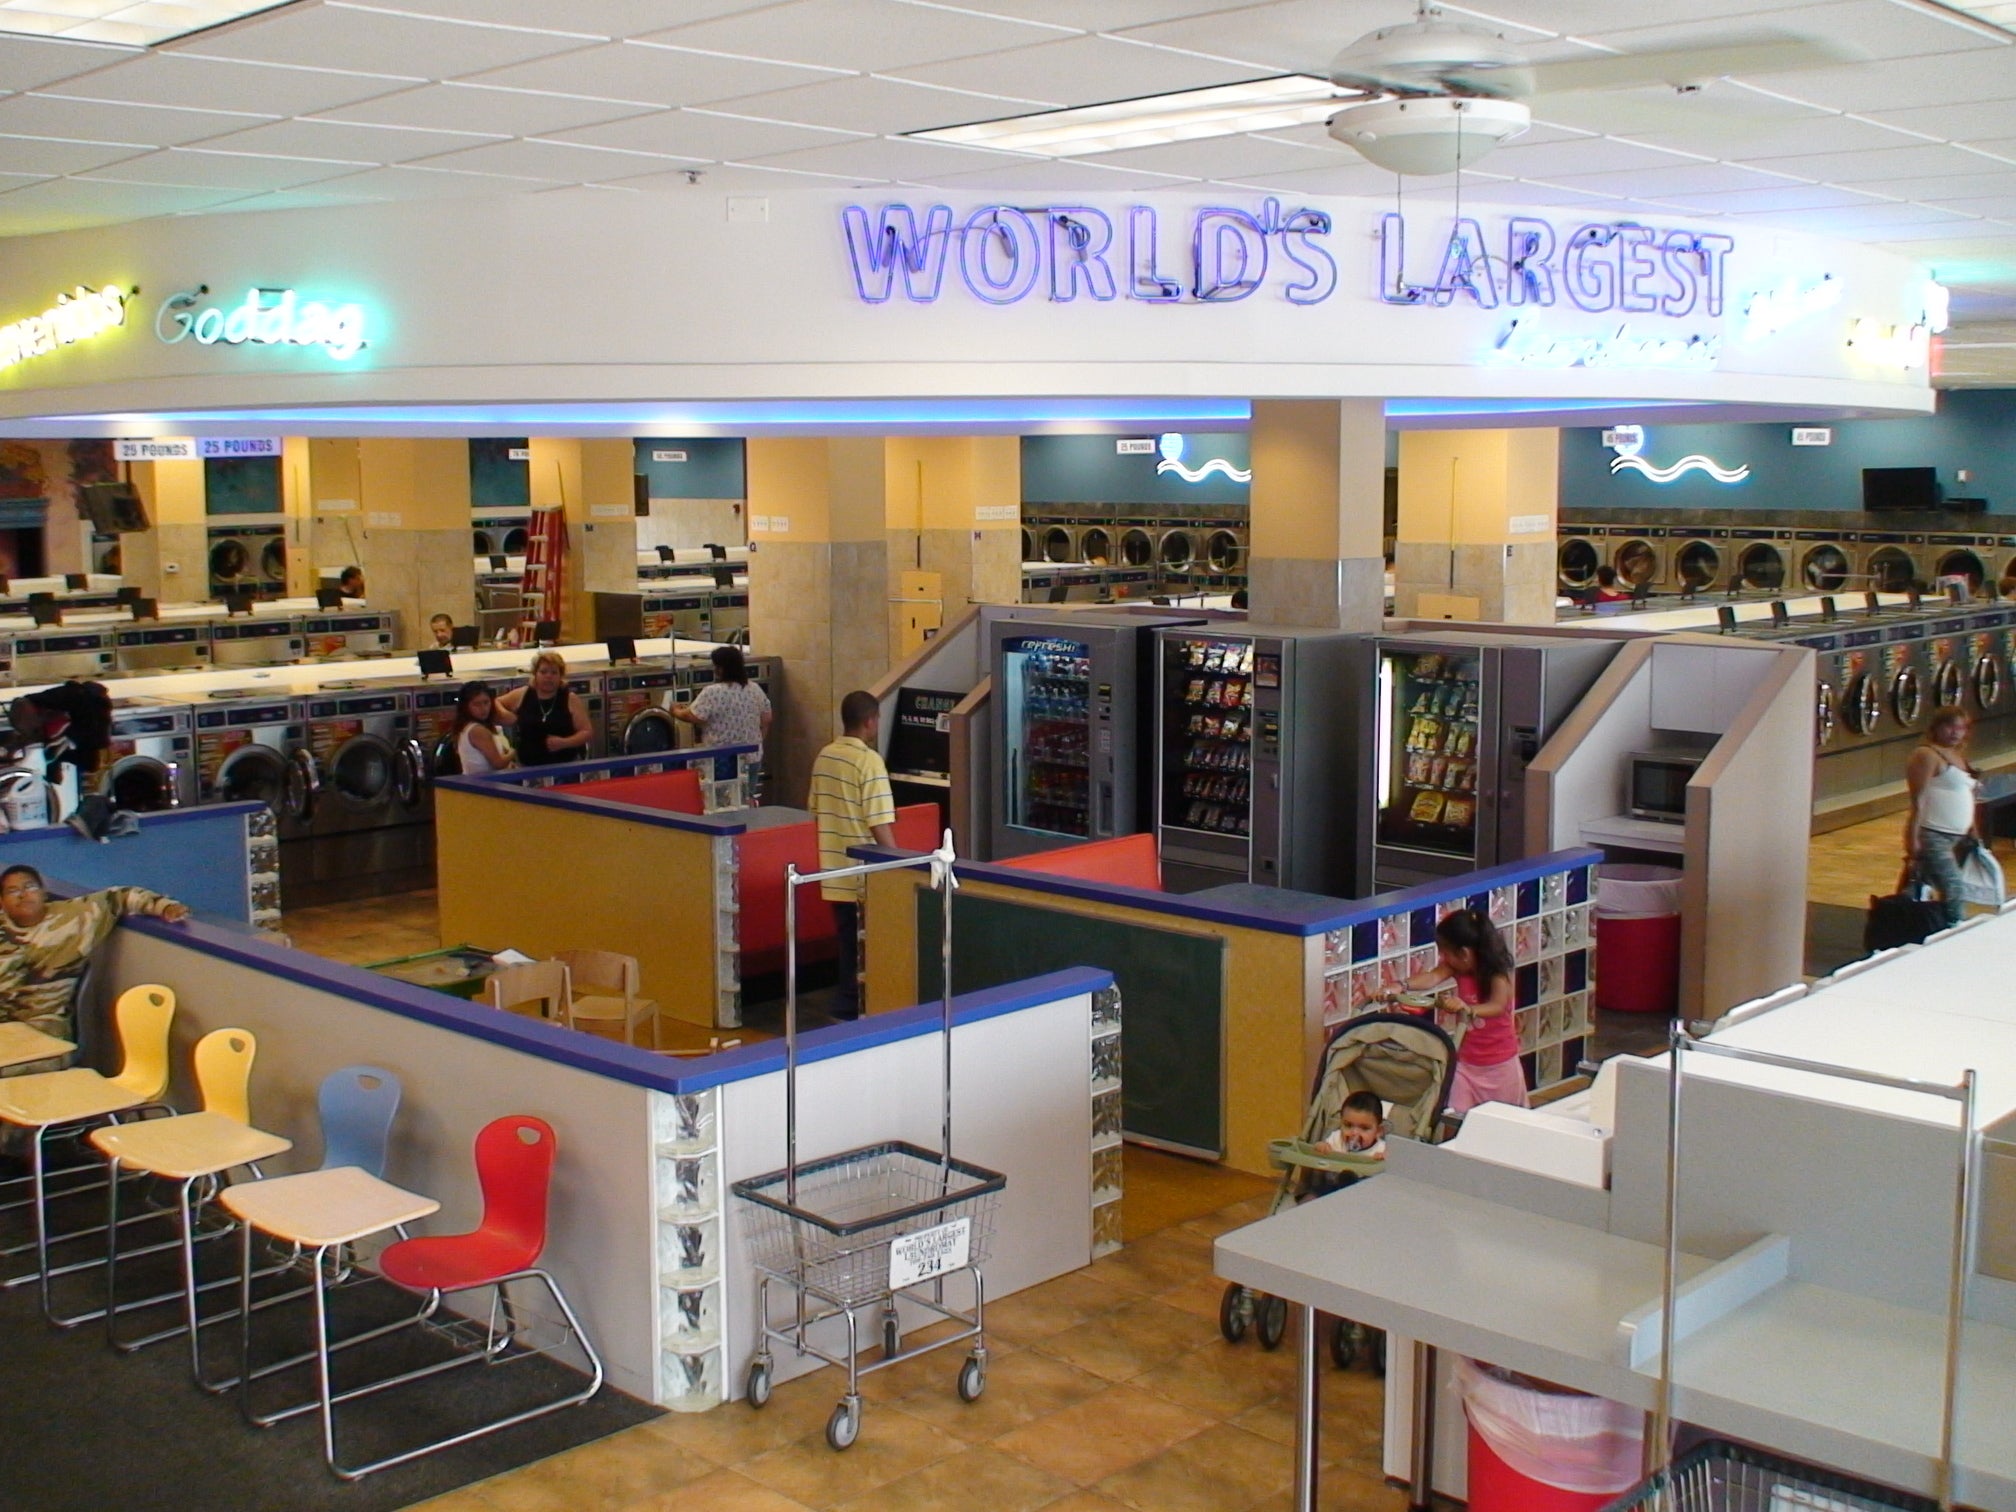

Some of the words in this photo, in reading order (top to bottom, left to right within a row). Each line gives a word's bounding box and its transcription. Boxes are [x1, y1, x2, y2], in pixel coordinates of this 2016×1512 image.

[842, 199, 1339, 304] WORLD'S
[1381, 211, 1735, 317] LARGEST
[155, 288, 366, 360] Goddag
[123, 445, 137, 457] 25
[141, 444, 188, 456] POUNDS
[204, 441, 220, 454] 25
[224, 439, 273, 453] POUNDS
[749, 542, 757, 552] Q
[918, 1259, 942, 1278] 234
